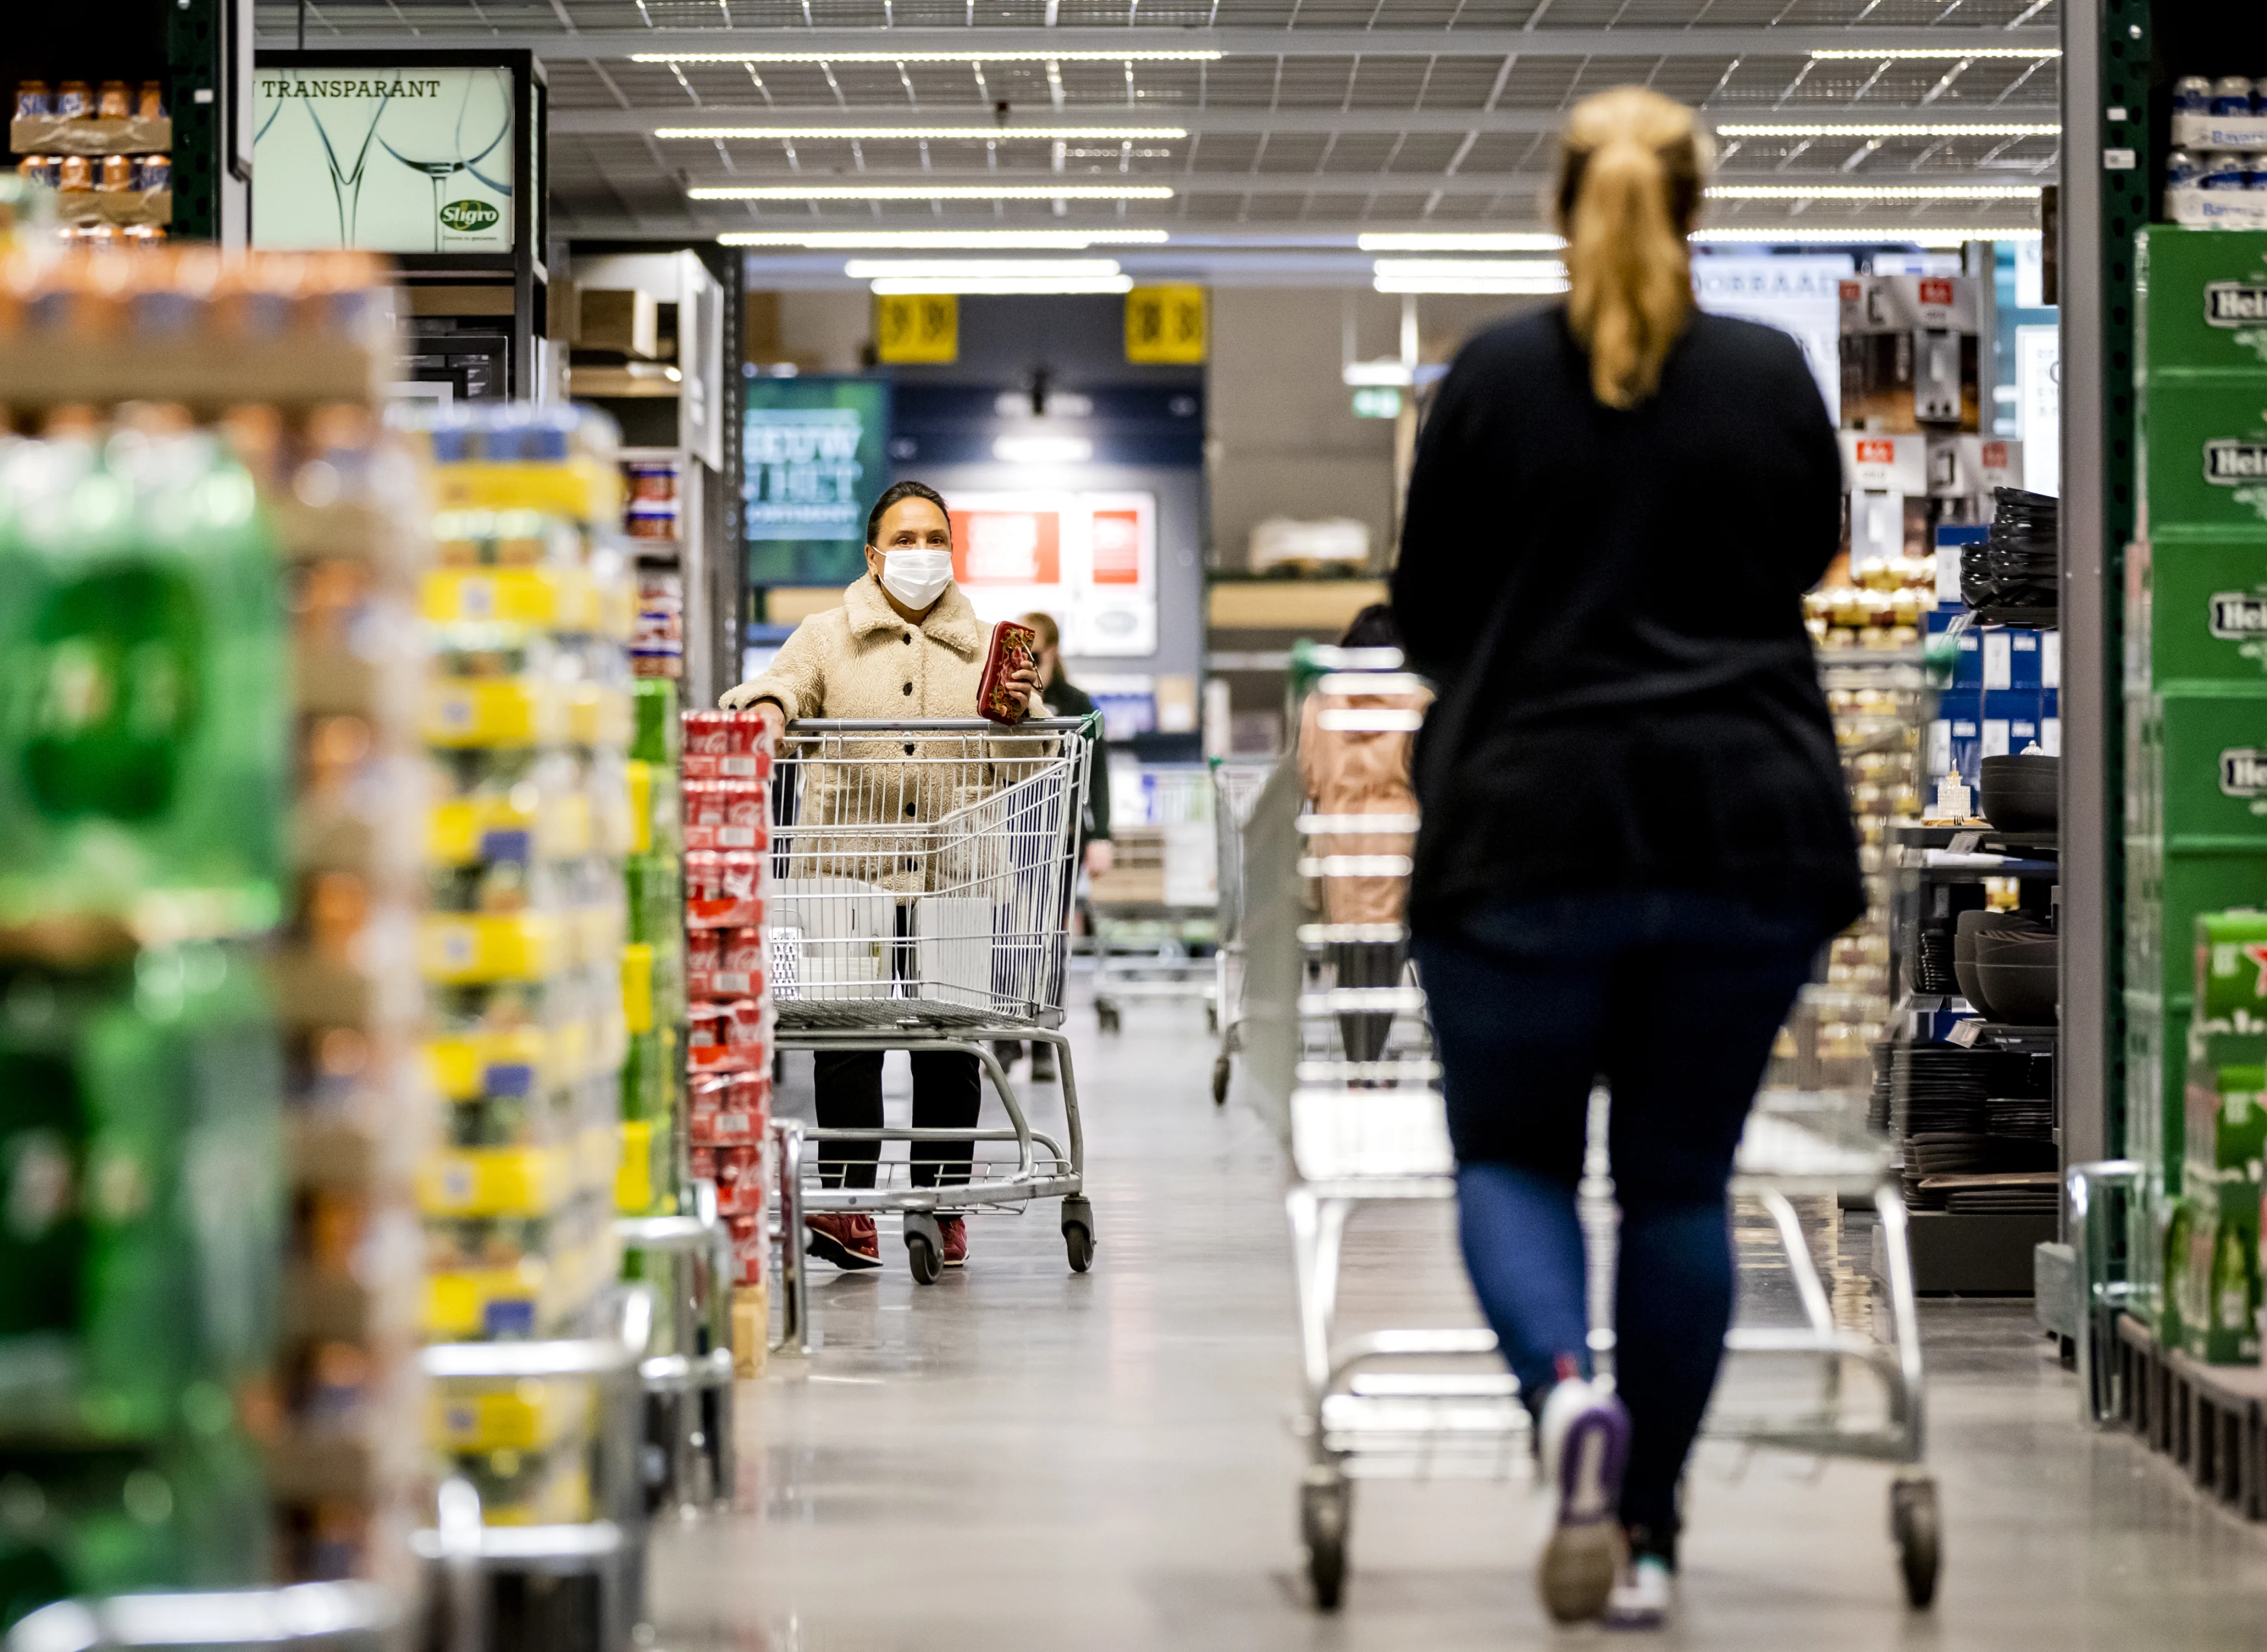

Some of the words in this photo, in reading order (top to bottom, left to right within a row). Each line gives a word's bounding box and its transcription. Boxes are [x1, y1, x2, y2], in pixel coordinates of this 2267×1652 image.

[262, 80, 440, 98] TRANSPARANT
[442, 207, 497, 224] Sligro
[2219, 291, 2267, 317] Hei
[2218, 449, 2267, 475] Hei
